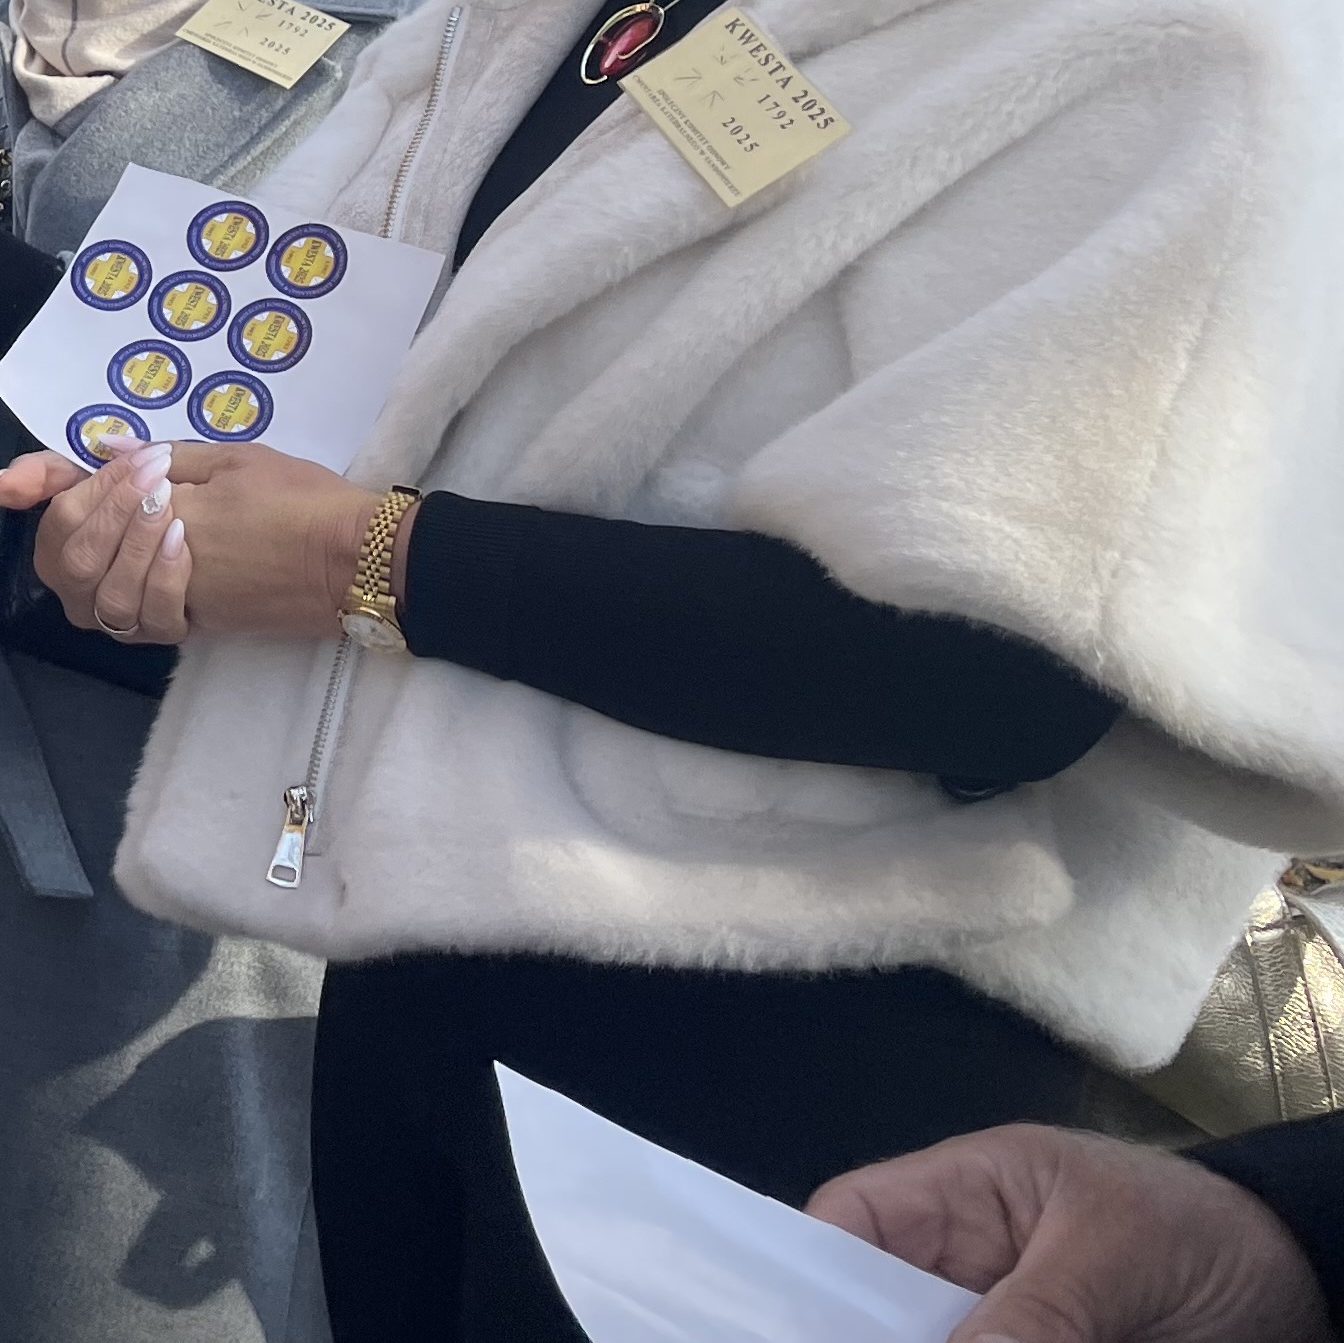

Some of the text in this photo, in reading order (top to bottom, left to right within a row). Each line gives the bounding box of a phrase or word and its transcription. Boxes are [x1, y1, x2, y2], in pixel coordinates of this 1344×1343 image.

[277, 19, 309, 38] 1792
[300, 11, 337, 32] 2025
[259, 37, 292, 56] 2025
[724, 17, 835, 130] KWESTA 2025
[757, 93, 795, 130] 1792
[721, 116, 760, 153] 2025
